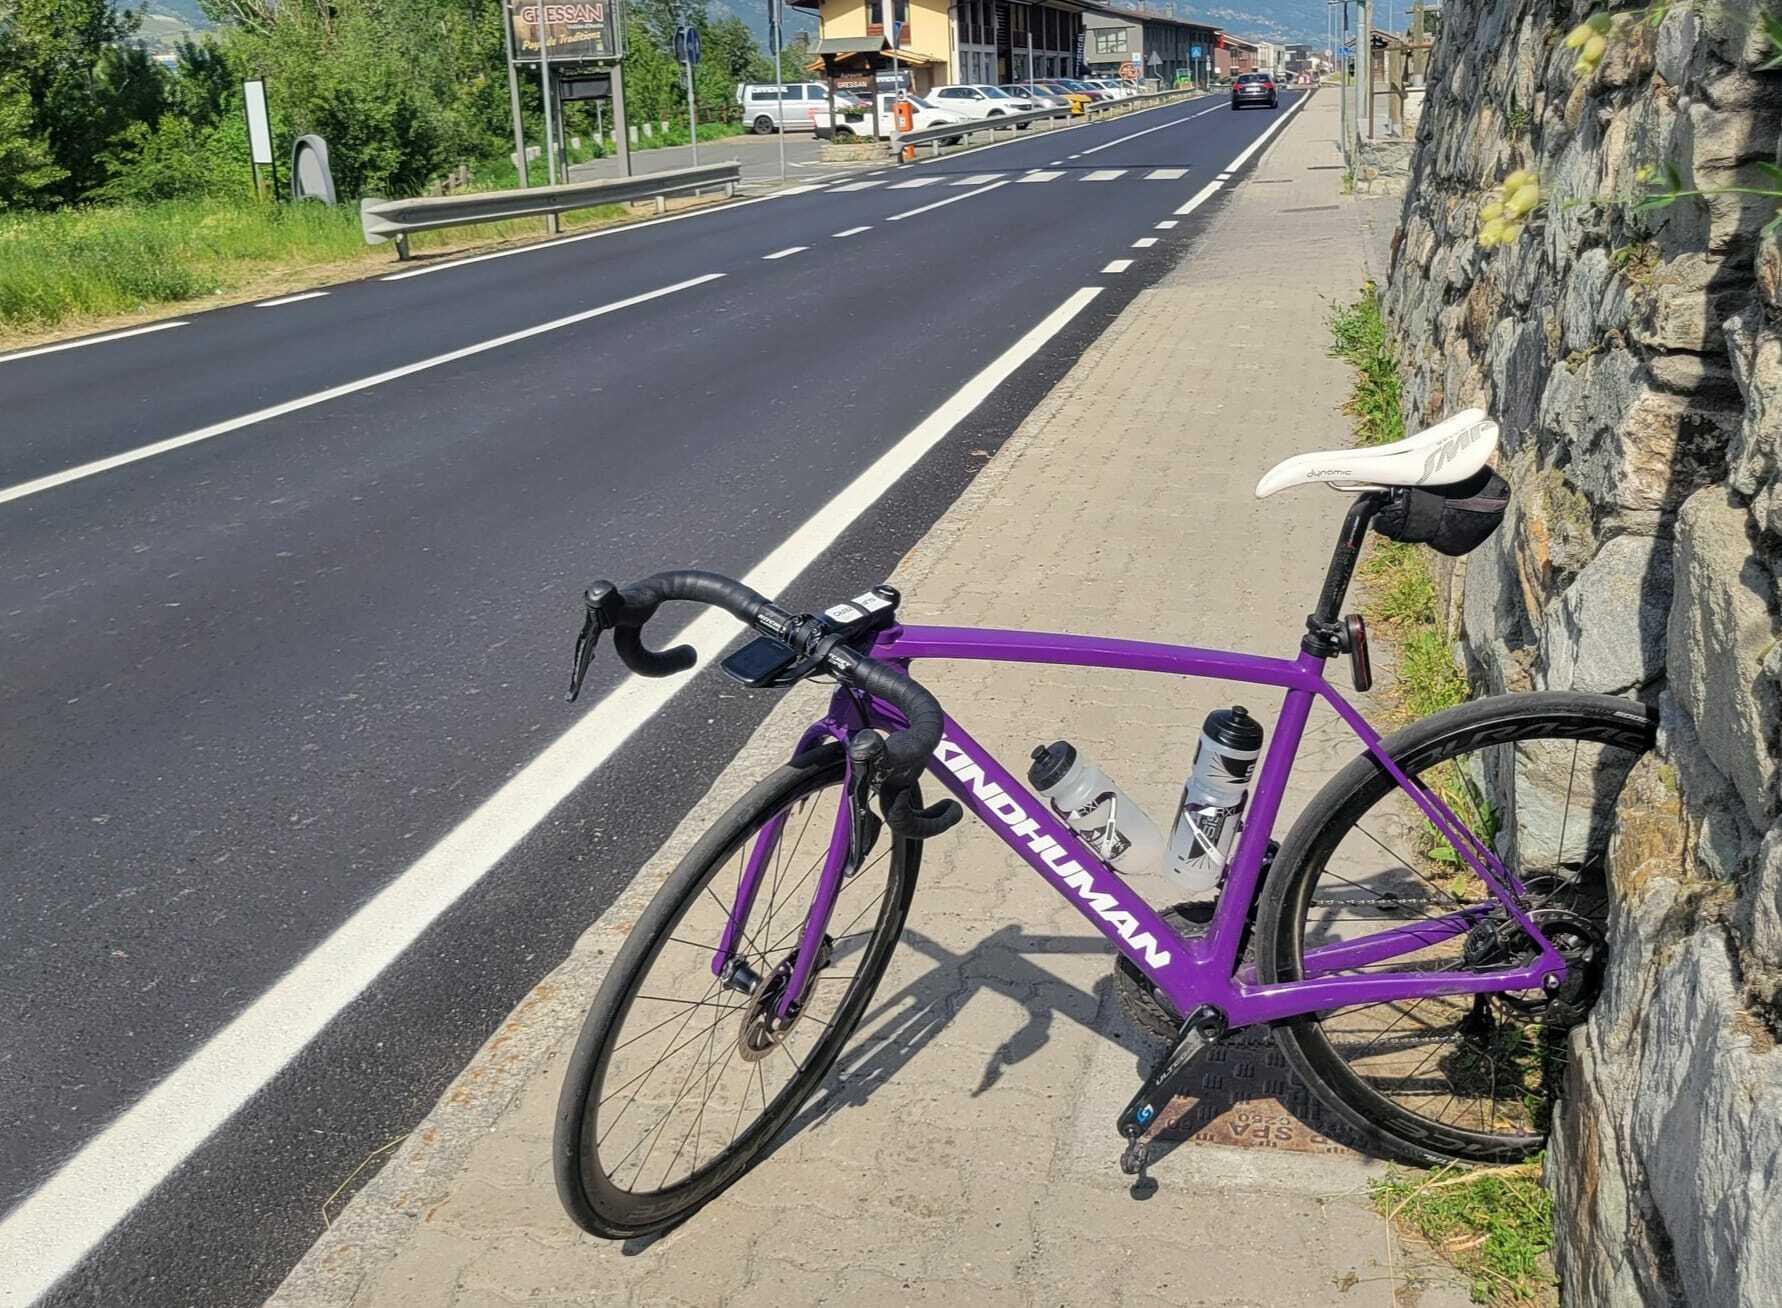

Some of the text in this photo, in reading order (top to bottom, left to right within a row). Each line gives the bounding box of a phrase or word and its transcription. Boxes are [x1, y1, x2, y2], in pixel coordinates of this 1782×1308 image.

[1306, 468, 1352, 479] dynamic
[932, 732, 1171, 969] KINDHUMAN
[1228, 1122, 1293, 1142] SPA
